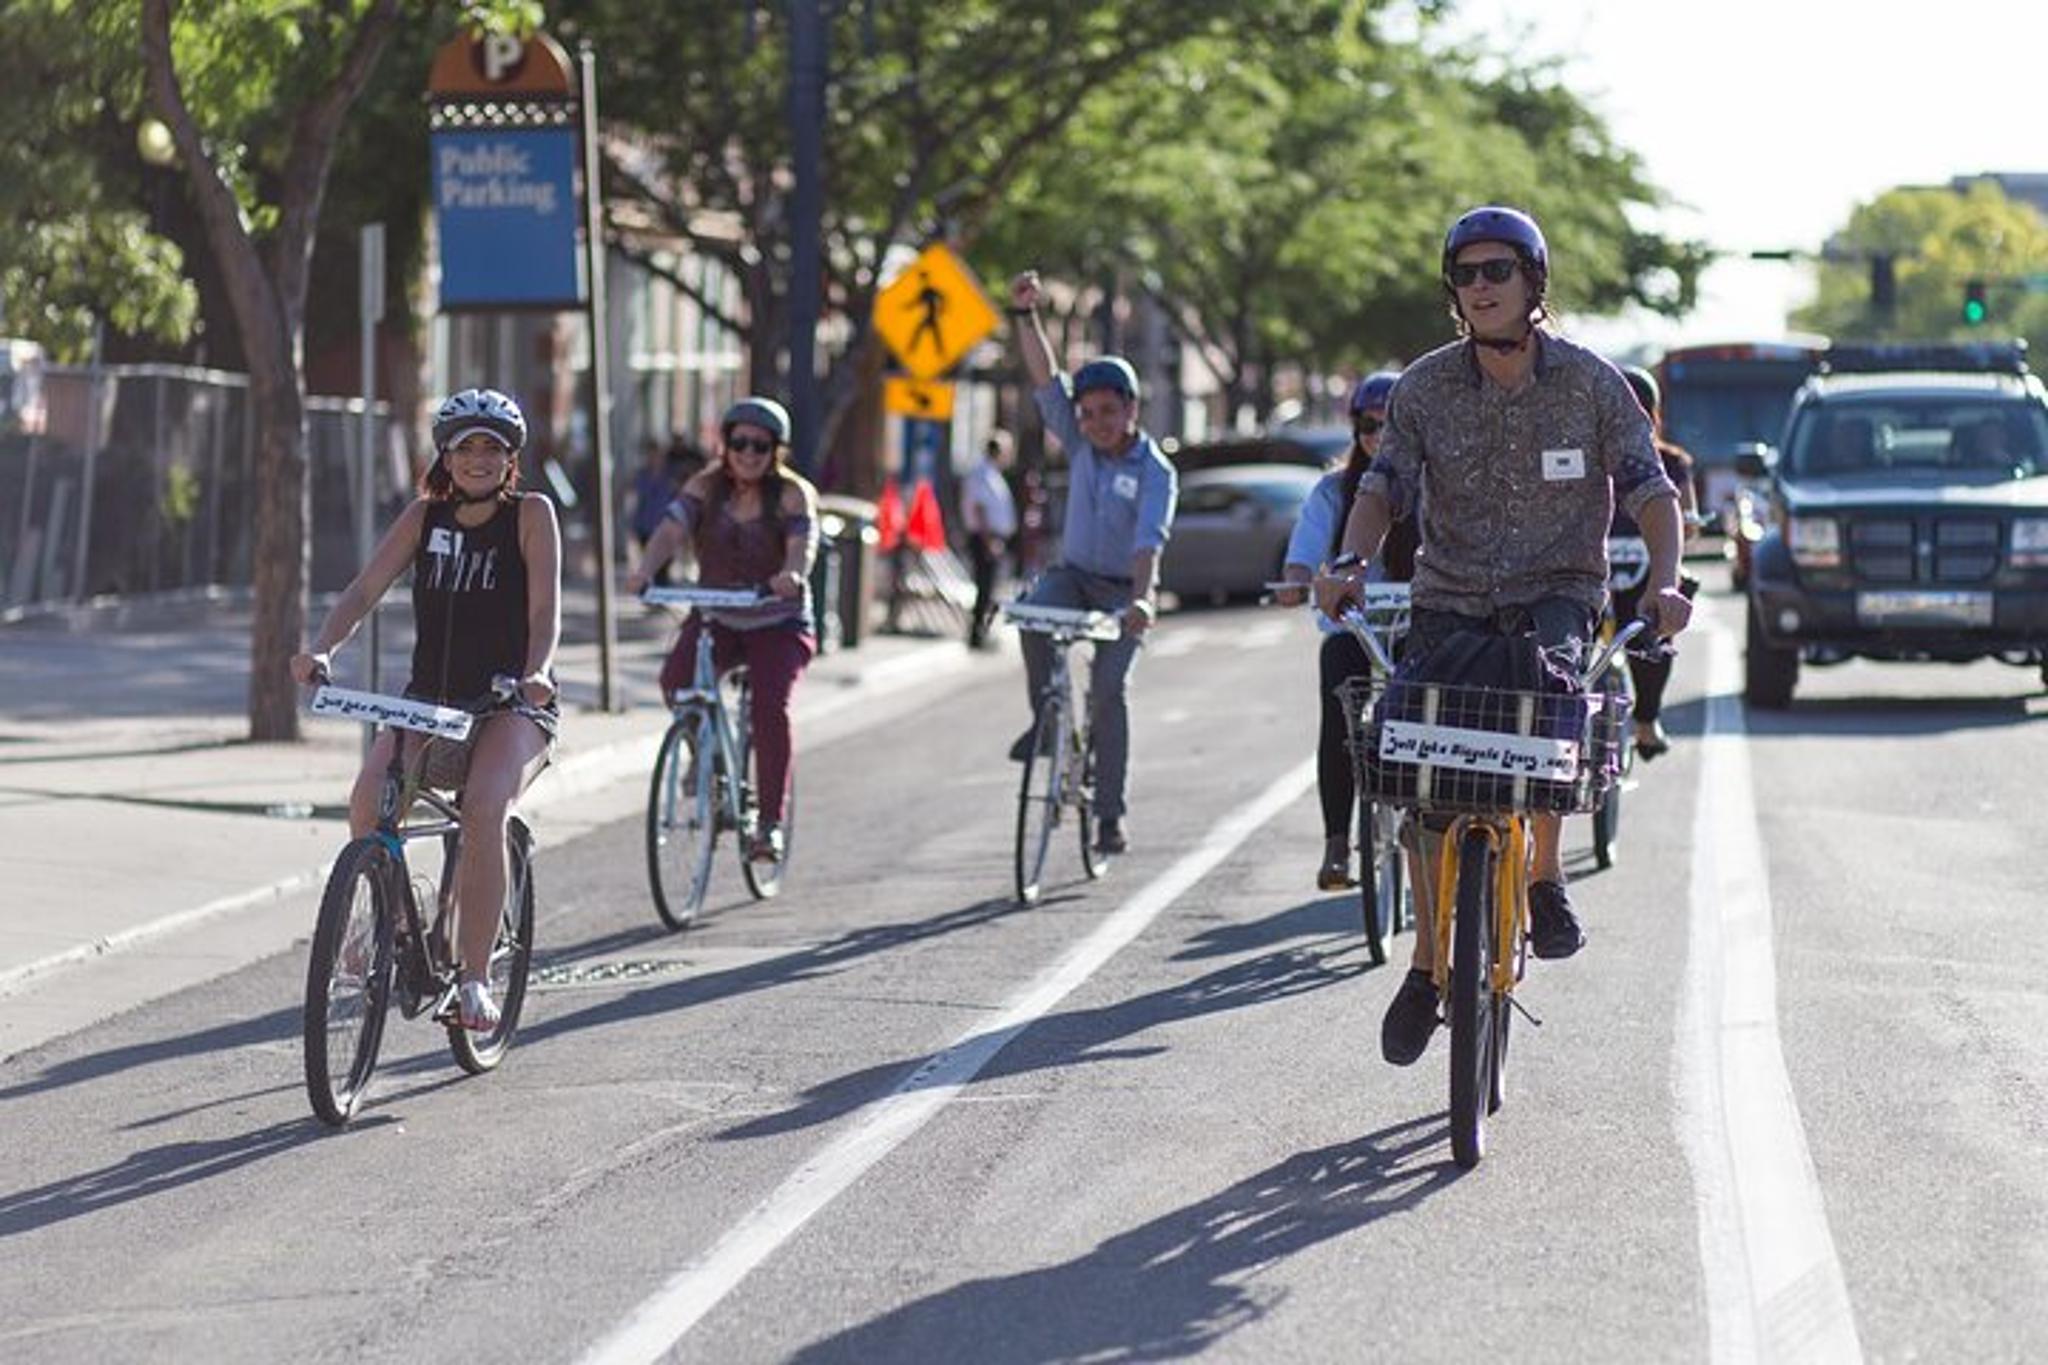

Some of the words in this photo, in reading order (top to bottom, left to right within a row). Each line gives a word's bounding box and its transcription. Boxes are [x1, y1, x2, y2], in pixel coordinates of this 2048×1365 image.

[484, 31, 523, 81] P
[440, 145, 530, 175] Public
[441, 178, 556, 215] Parking
[1417, 739, 1447, 759] Lake
